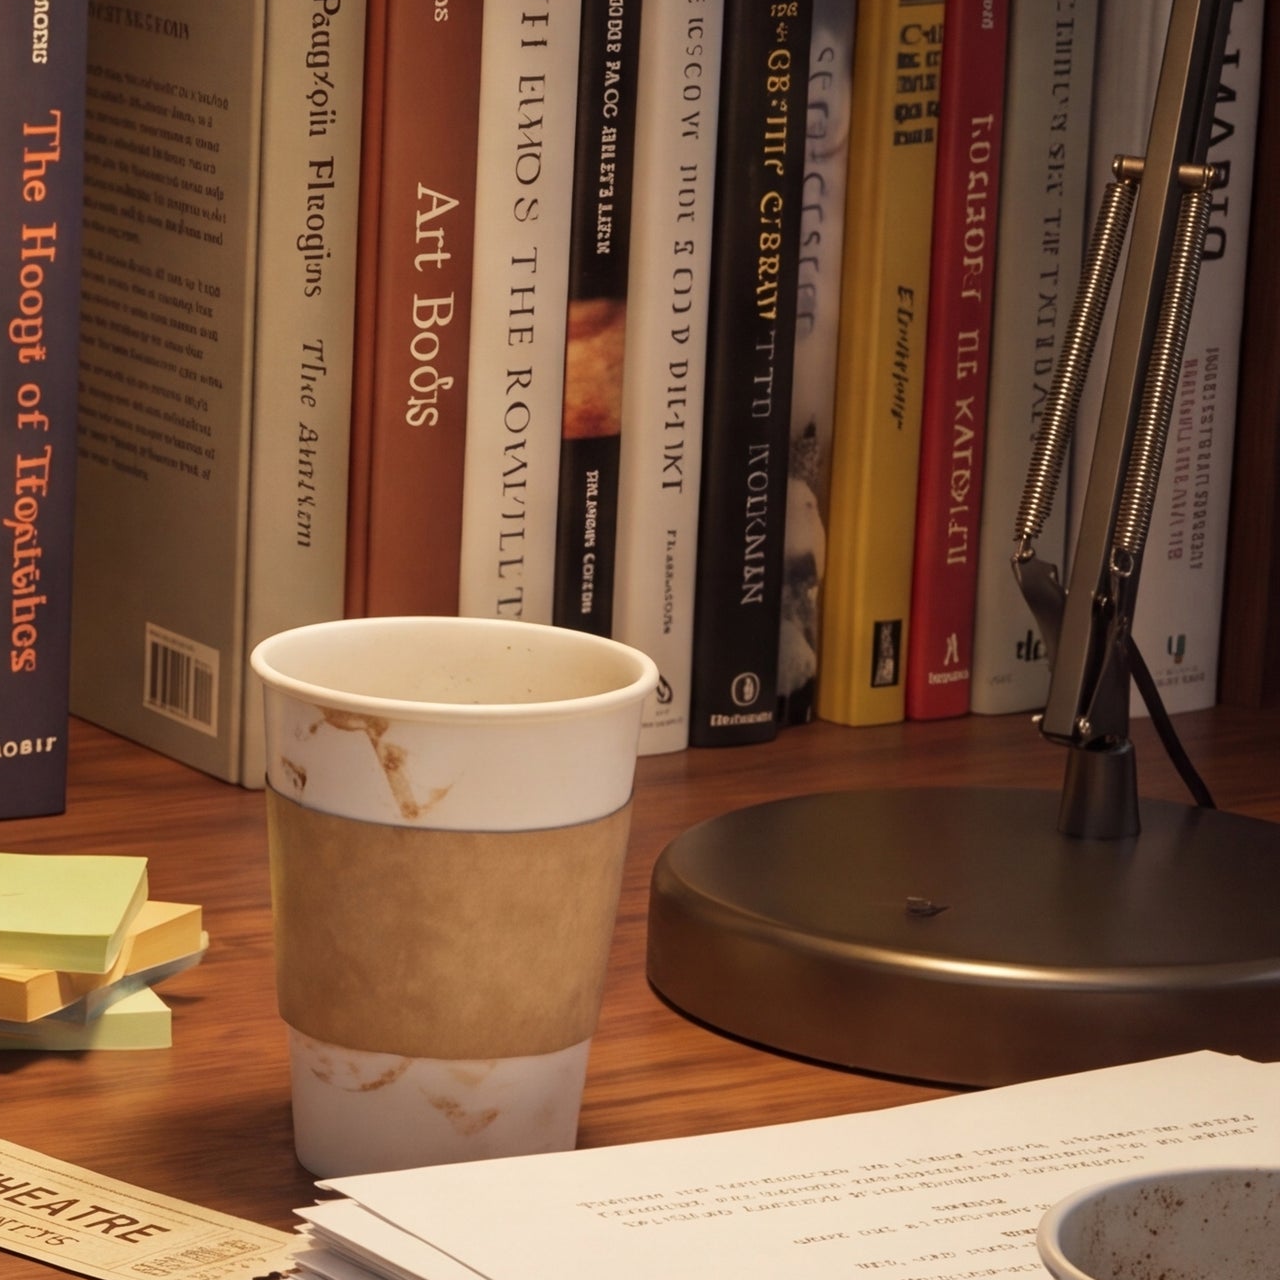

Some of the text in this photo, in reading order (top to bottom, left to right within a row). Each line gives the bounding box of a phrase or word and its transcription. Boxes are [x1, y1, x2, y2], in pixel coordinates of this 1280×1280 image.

[22, 110, 61, 202] The
[414, 183, 459, 272] Art
[508, 247, 537, 347] THE
[18, 385, 49, 430] of
